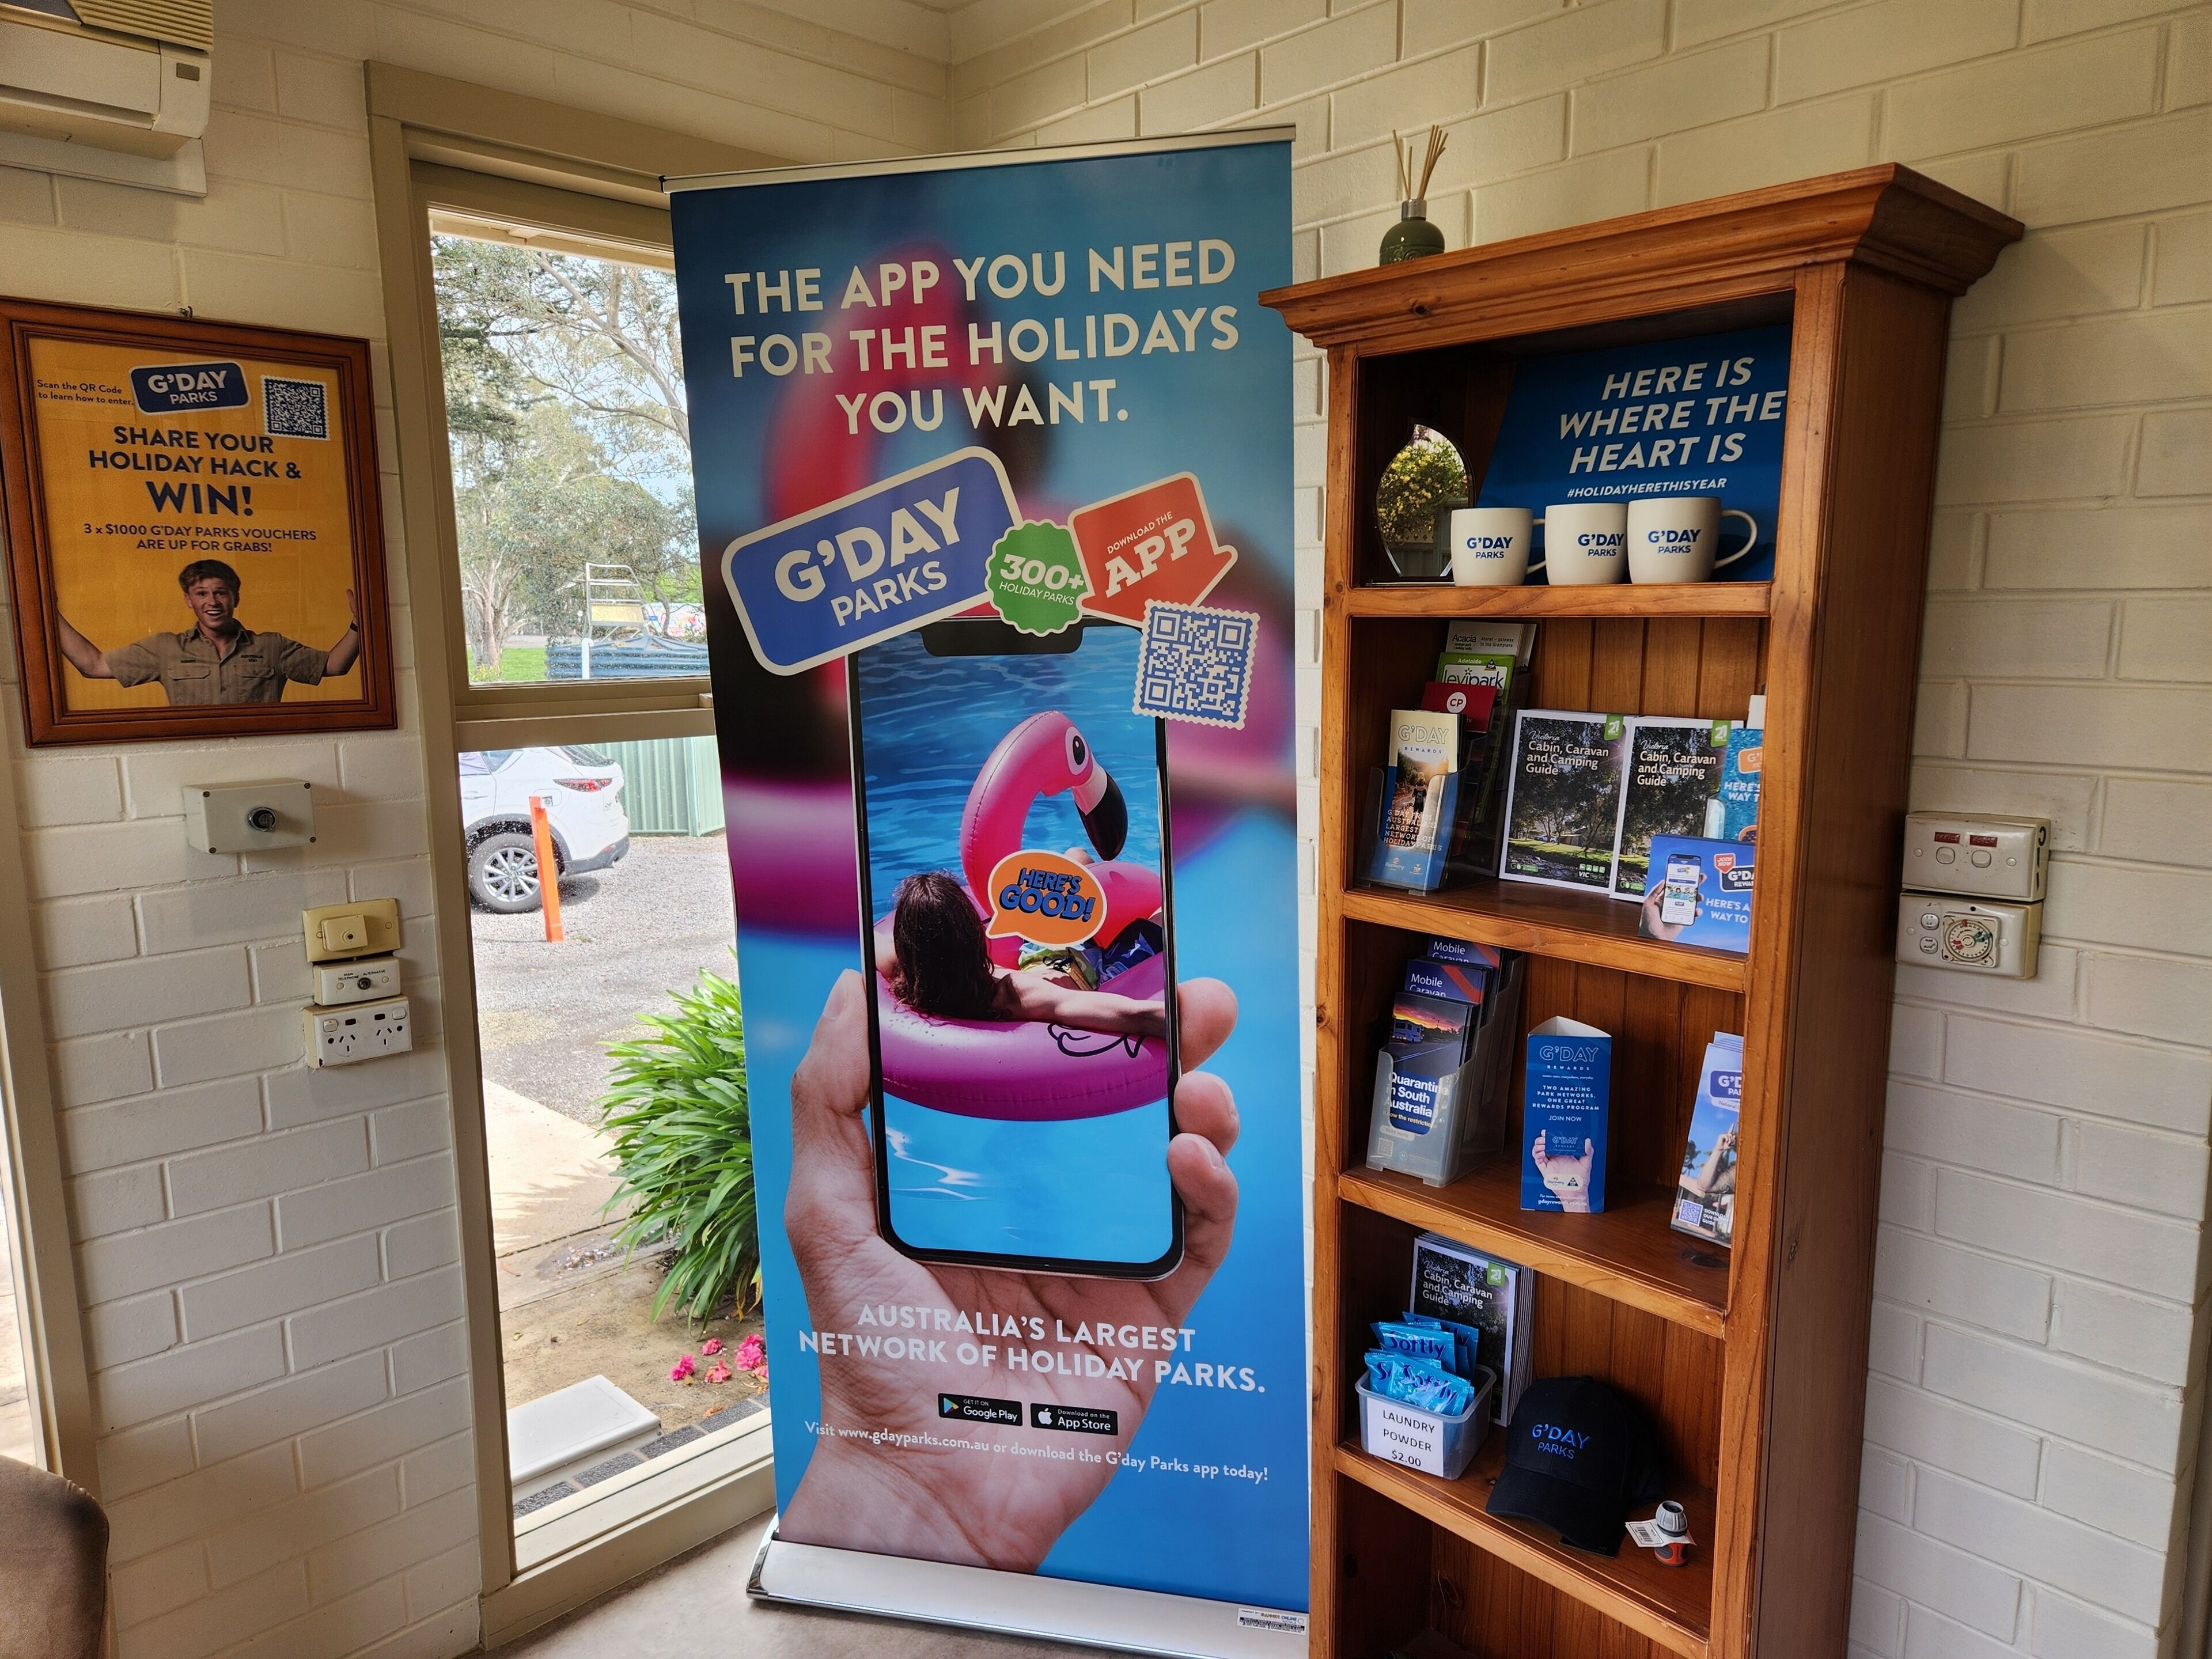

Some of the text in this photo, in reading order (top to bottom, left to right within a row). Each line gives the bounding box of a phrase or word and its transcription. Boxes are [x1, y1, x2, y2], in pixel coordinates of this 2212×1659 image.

[725, 238, 1236, 316] THE APP YOU NEED
[730, 304, 1240, 378] FOR THE HOLIDAYS
[37, 380, 122, 394] Scan the QR Code
[147, 370, 227, 393] G'DAY
[1601, 356, 1755, 402] HERE IS
[50, 392, 73, 402] learn
[75, 394, 93, 402] how
[170, 391, 218, 404] PARKS
[835, 378, 1130, 435] YOU WANT.
[1559, 390, 1787, 441] WHERE THE
[114, 426, 274, 454] SHARE YOUR
[1569, 432, 1747, 475] HEART IS
[89, 450, 302, 479] HOLIDAY HACK &
[1567, 478, 1727, 498] #HOLIDAYHERETHISYEAR
[146, 481, 253, 517] WIN!
[84, 523, 92, 533] 3
[105, 523, 146, 536] $1000
[150, 525, 191, 536] G'DAY
[195, 527, 239, 538] PARKS
[241, 528, 317, 540] VOUCHERS
[1107, 511, 1173, 555] DOWNLOAD THE
[1578, 533, 1624, 547] G'DAY
[1647, 529, 1702, 544] G'DAY
[137, 539, 272, 552] ARE UP FOR GRABS!
[775, 486, 960, 602] G'DAY
[1467, 536, 1514, 550] G'DAY
[1658, 545, 1691, 554] PARKS
[1105, 518, 1196, 599] APP
[1588, 548, 1617, 556] PARKS
[1000, 554, 1084, 590] 300+
[830, 560, 948, 627] PARKS
[999, 581, 1075, 605] HOLIDAY PARKS
[1452, 634, 1476, 642] Acacia
[1444, 668, 1504, 689] levipark
[1450, 698, 1464, 707] CP
[1398, 725, 1449, 744] G'DAY
[1528, 730, 1560, 741] Victoria
[1608, 720, 1620, 734] 21
[1714, 725, 1728, 739] 21
[1528, 741, 1609, 757] Cabin, Caravan
[1641, 740, 1669, 750] Victoria
[1527, 753, 1599, 770] and Camping
[1640, 751, 1716, 765] Cabin, Caravan
[1526, 763, 1558, 775] Guide
[1638, 764, 1705, 780] and Camping
[1637, 775, 1666, 786] Guide
[1728, 792, 1751, 801] WAY
[1385, 824, 1419, 833] LARGEST
[1017, 867, 1083, 894] HERE'S
[999, 884, 1096, 922] GOOD!
[1706, 897, 1750, 912] HERE'S A
[1710, 911, 1748, 923] WAY TO
[1434, 941, 1465, 955] Mobile
[1411, 974, 1443, 987] Mobile
[1540, 1046, 1599, 1062] G'DAY
[1397, 1086, 1430, 1104] South
[1424, 1260, 1449, 1275] Victoria
[1424, 1270, 1493, 1300] Cabin, Caravan
[1423, 1282, 1483, 1309] and Camping
[1423, 1290, 1449, 1305] Guide
[857, 1304, 1196, 1352] AUSTRALIA'S LARGEST
[799, 1330, 1266, 1393] NETWORK OF HOLIDAY PARKS.
[963, 1406, 1018, 1422] Google Play
[1058, 1409, 1088, 1418] Download
[1382, 1410, 1435, 1433] LAUNDRY
[1058, 1416, 1111, 1430] App Store
[1384, 1429, 1431, 1452] POWDER
[1532, 1423, 1591, 1449] G'DAY
[805, 1421, 1268, 1484] Visit www.gdayparks.com.au or download the G'day Parks app today!
[1392, 1450, 1421, 1467] $2.00
[1537, 1442, 1575, 1459] PARKS
